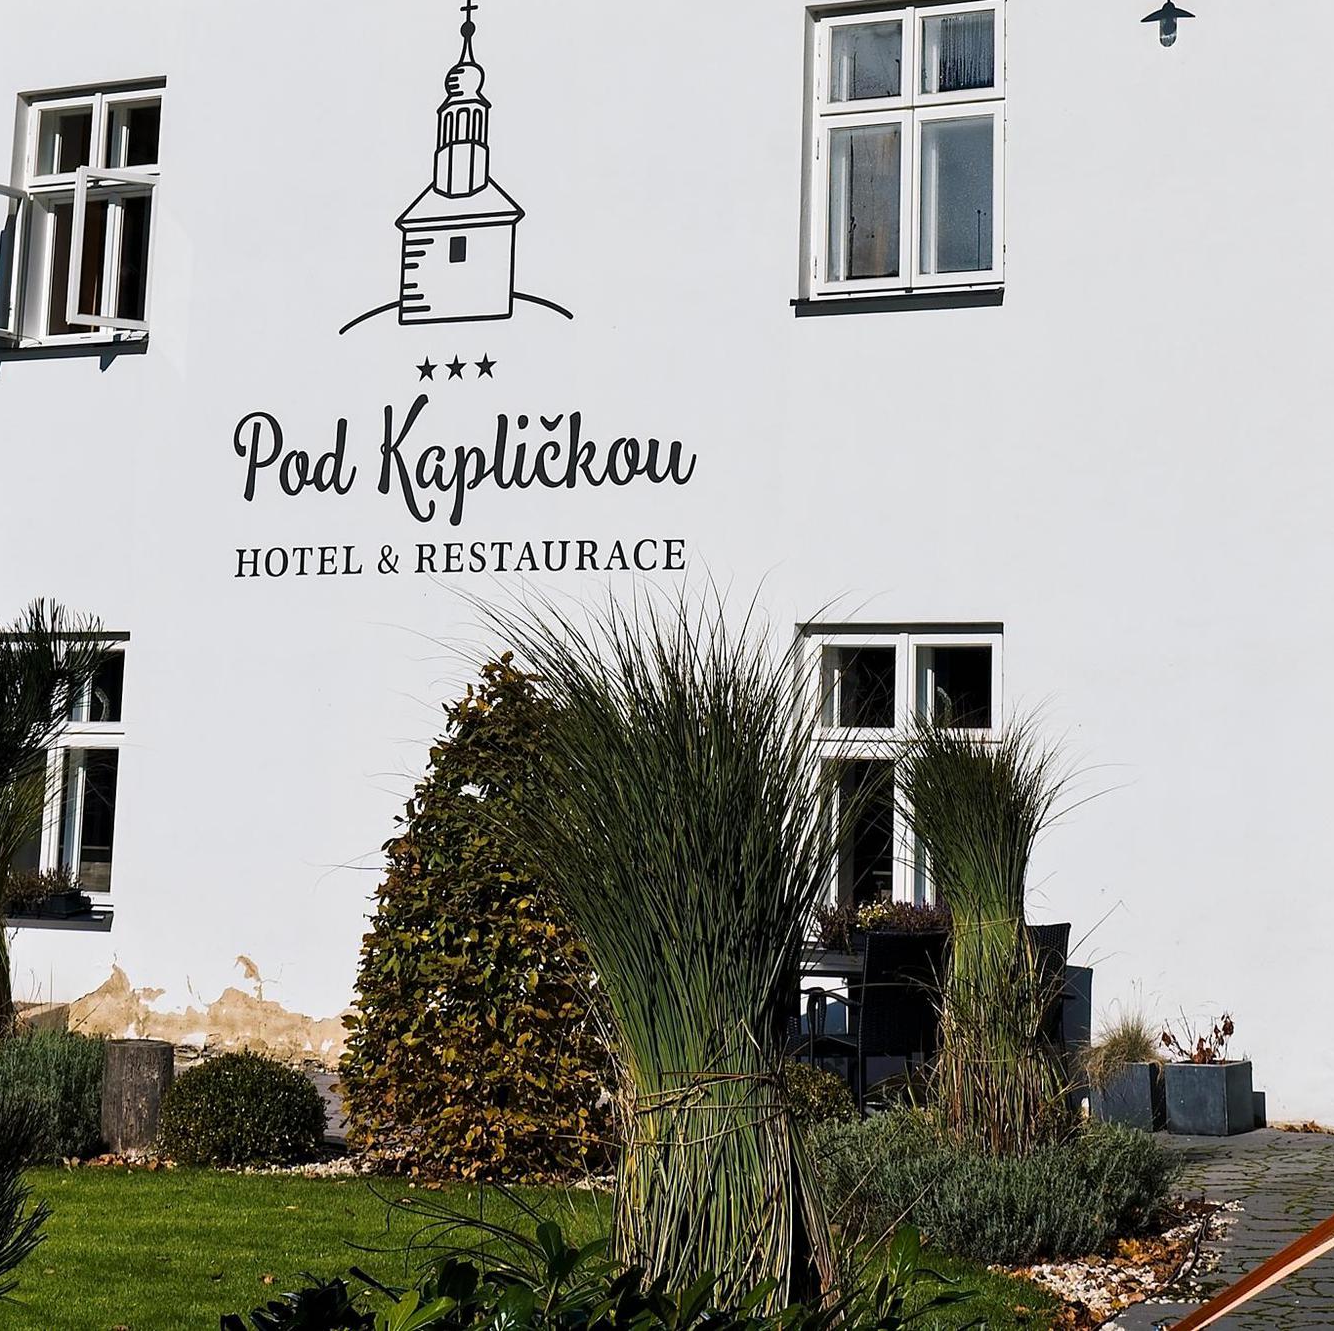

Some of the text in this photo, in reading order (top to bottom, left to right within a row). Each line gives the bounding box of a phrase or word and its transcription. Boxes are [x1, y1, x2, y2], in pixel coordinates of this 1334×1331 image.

[233, 393, 697, 527] Pod Kapličkou
[234, 538, 687, 578] HOTEL & RESTAURACE
